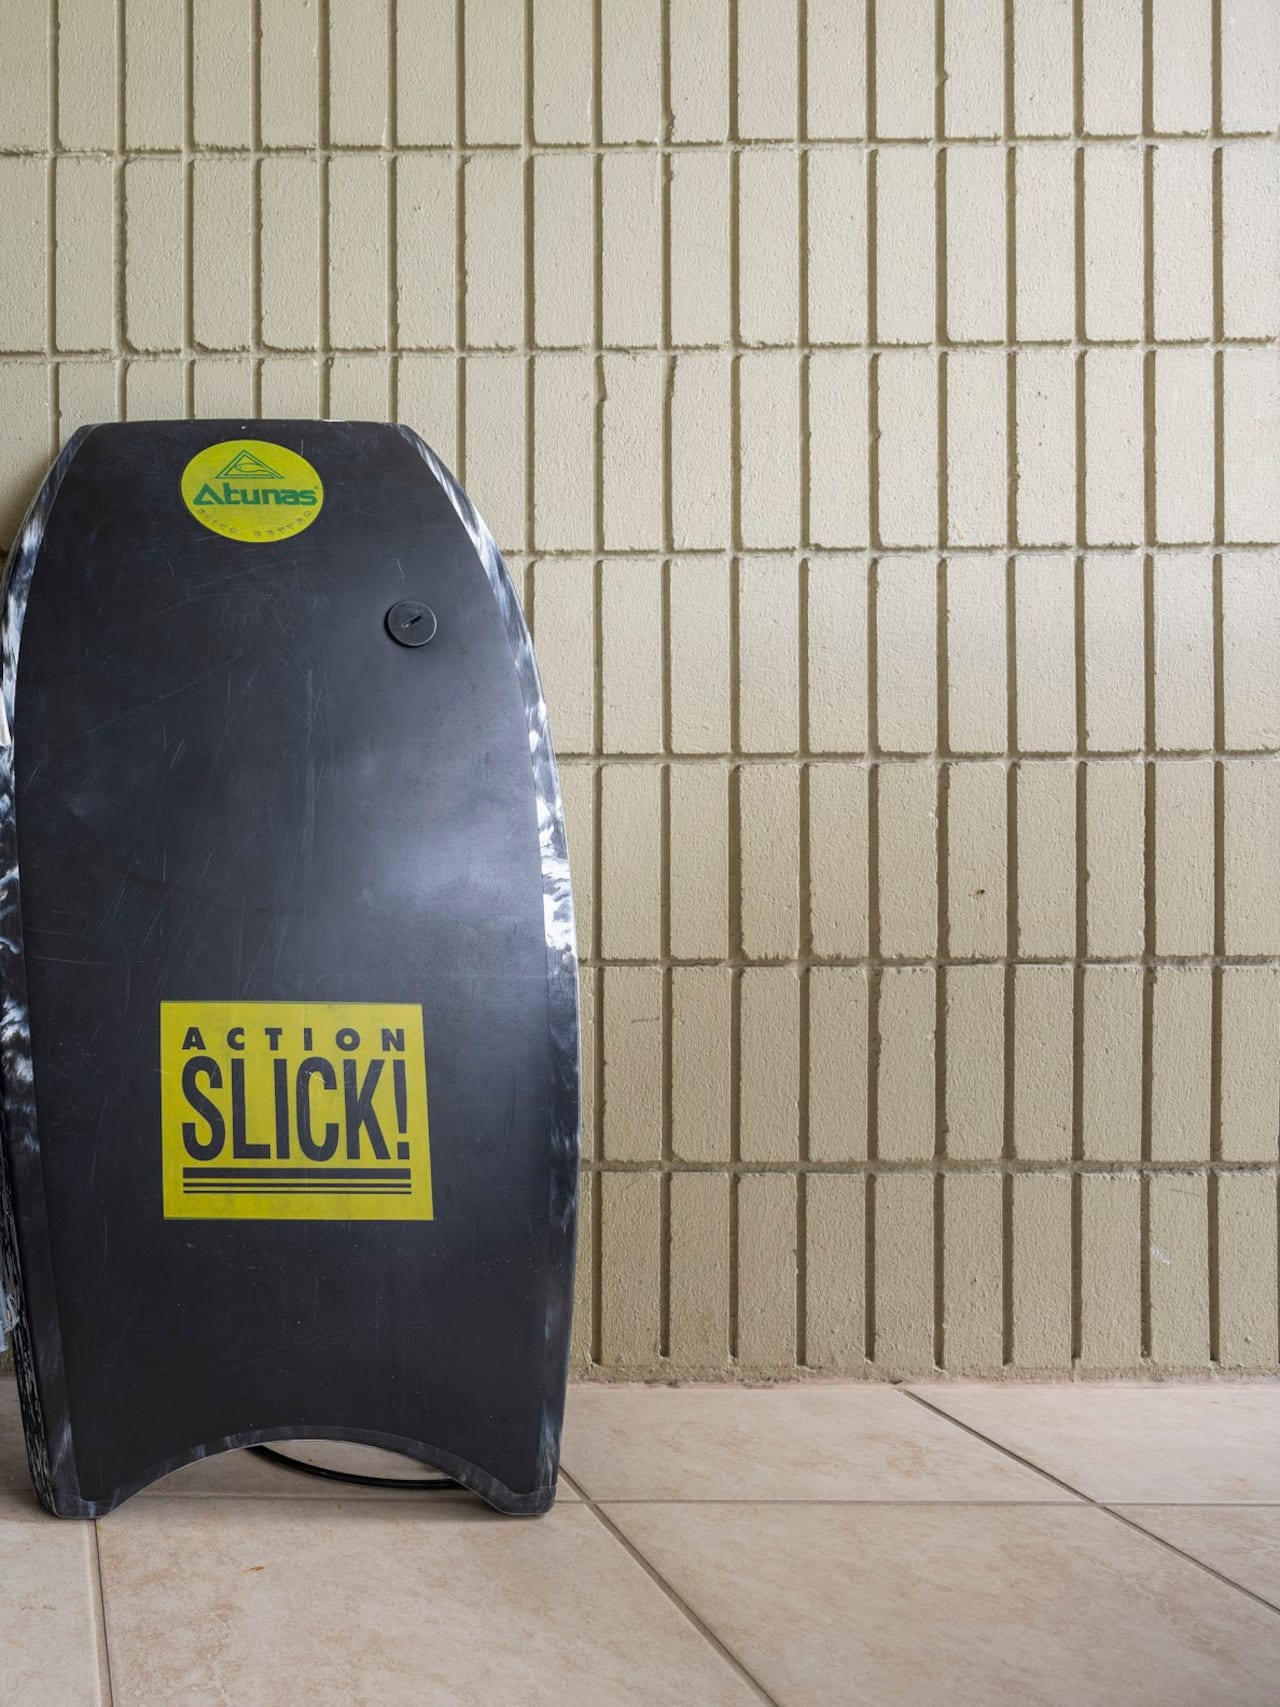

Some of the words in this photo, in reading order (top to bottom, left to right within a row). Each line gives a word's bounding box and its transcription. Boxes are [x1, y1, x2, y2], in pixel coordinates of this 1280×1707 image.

[193, 482, 318, 506] Atunas
[182, 1026, 405, 1052] ACTION
[181, 1055, 410, 1162] SLICK!
